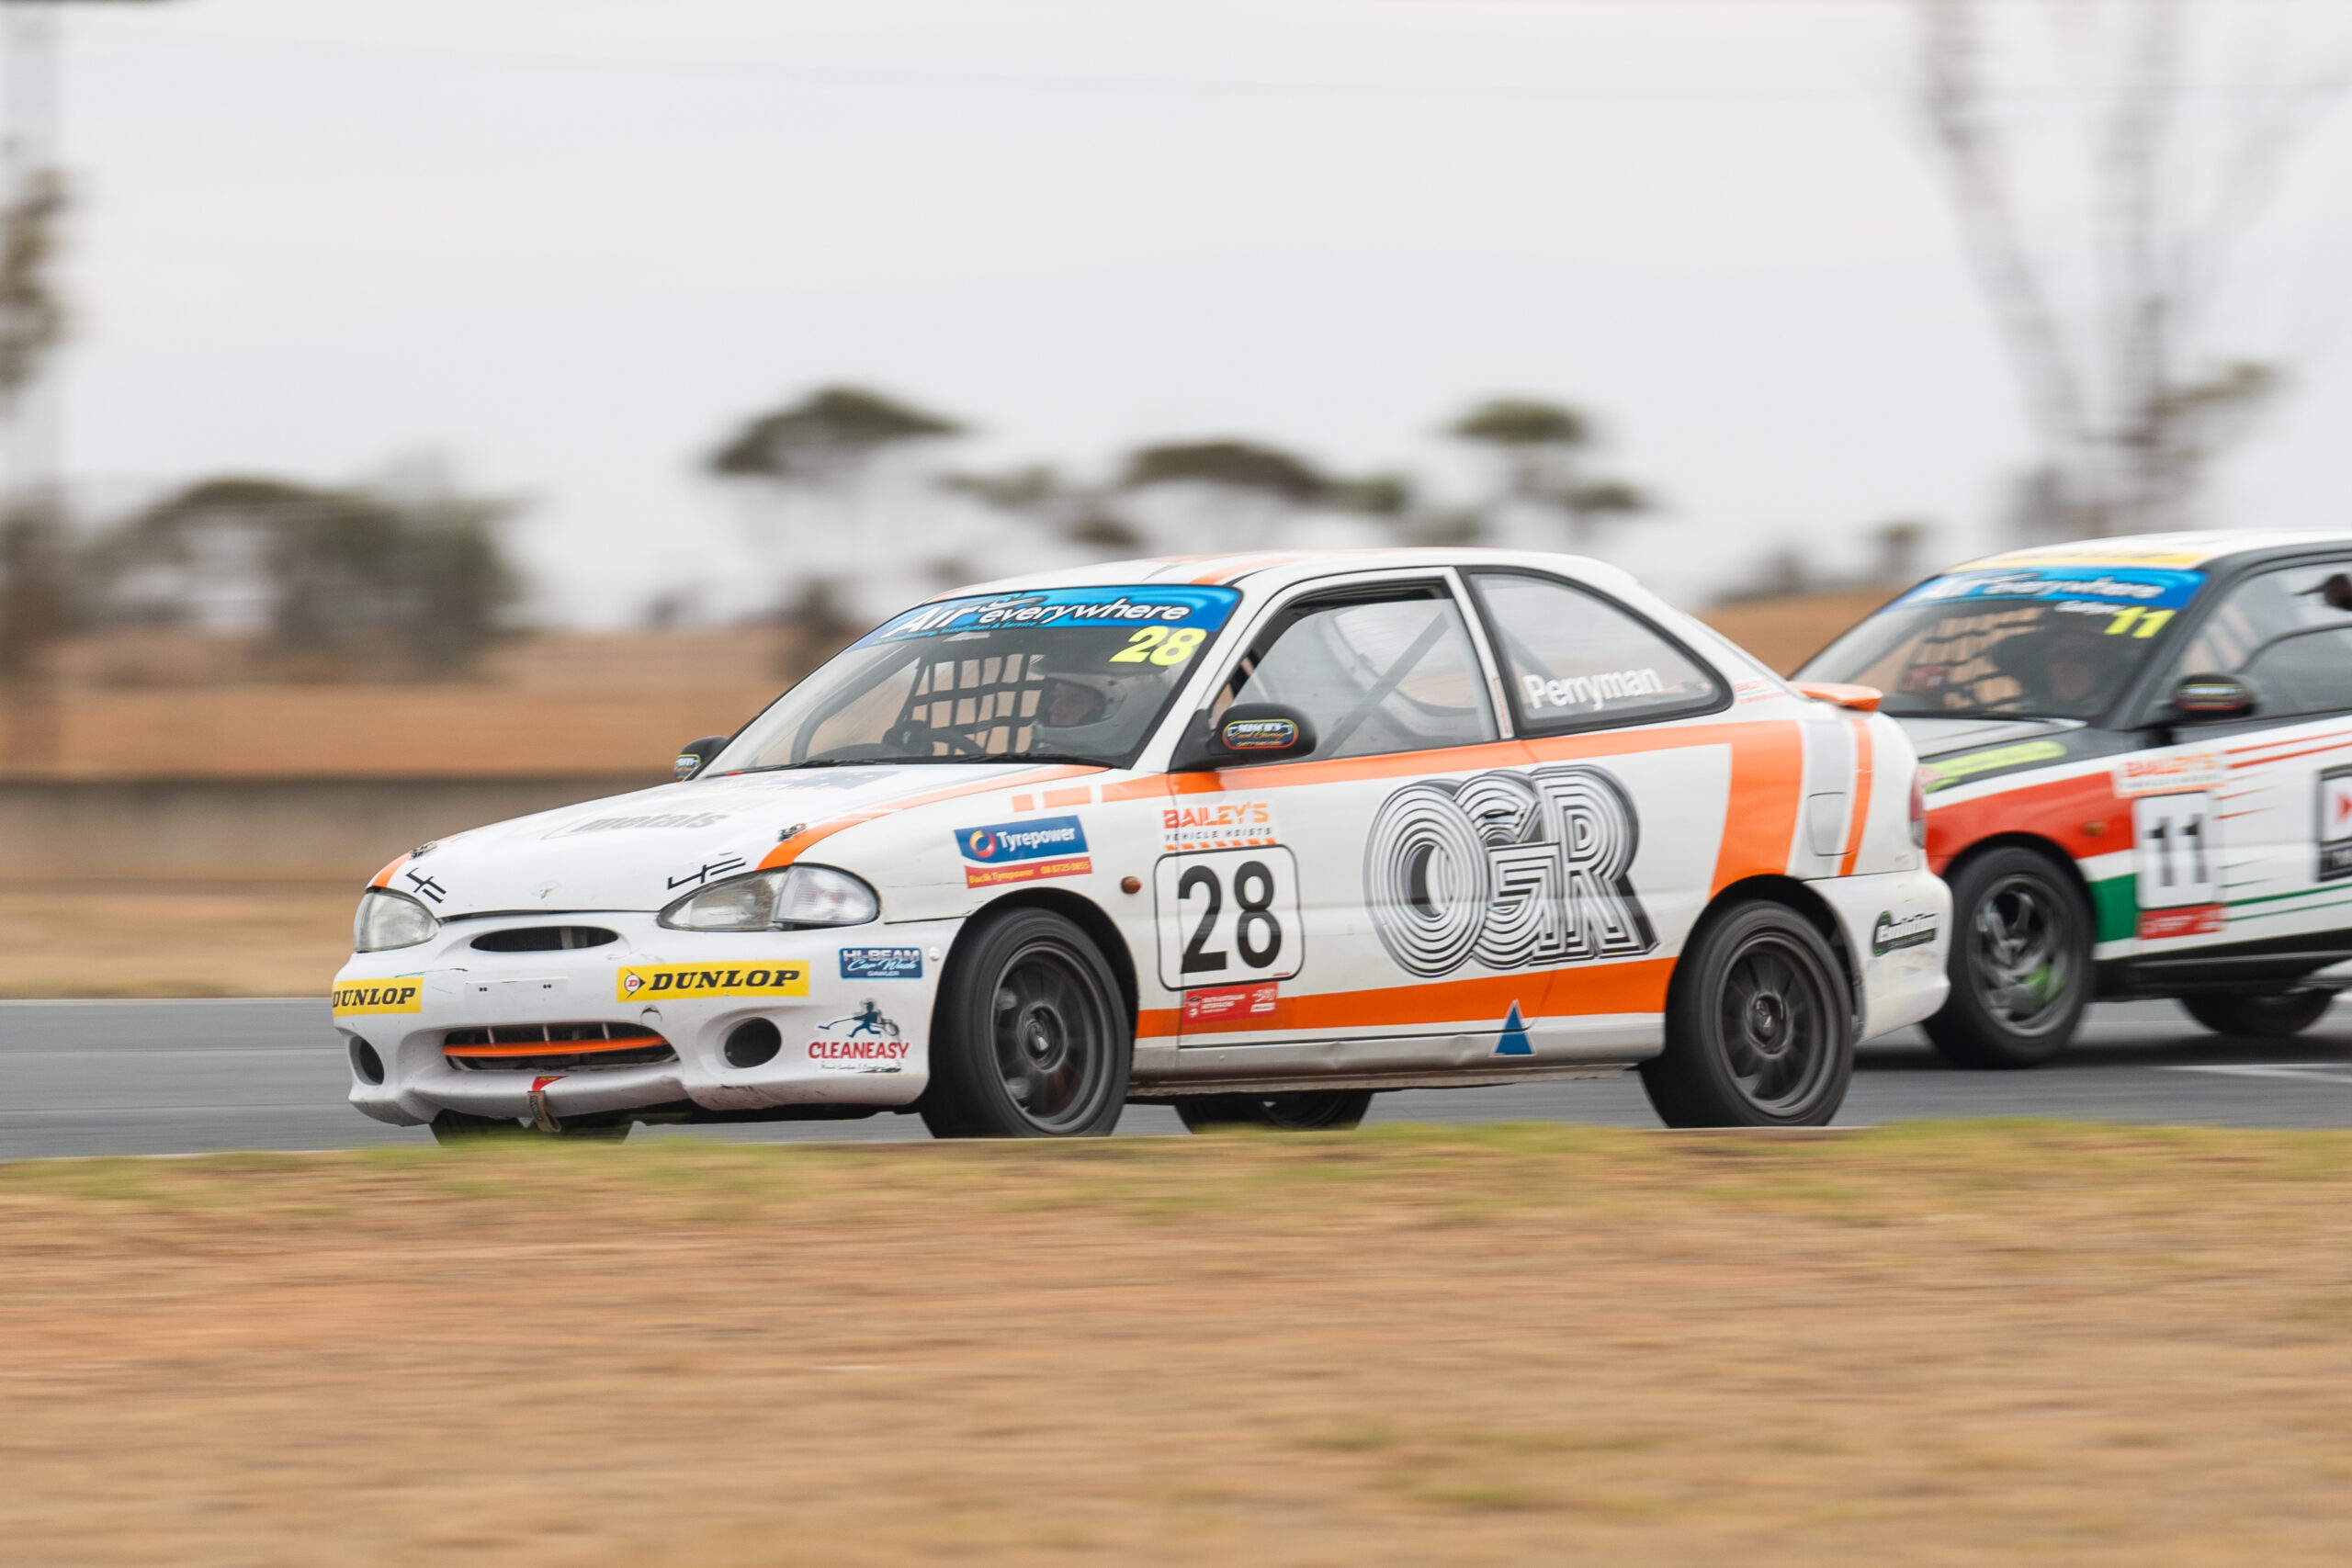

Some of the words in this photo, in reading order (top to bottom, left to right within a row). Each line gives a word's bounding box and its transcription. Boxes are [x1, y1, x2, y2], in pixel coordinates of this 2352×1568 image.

[978, 598, 1190, 624] everywhere
[2103, 606, 2177, 638] 11
[1109, 626, 1206, 666] 28
[1522, 668, 1664, 711] Perryman
[1162, 801, 1270, 829] BAILEY'S
[996, 828, 1076, 852] Tyrepower
[1165, 830, 1218, 841] VEHICLE
[1225, 828, 1272, 838] HOISTS
[2143, 813, 2209, 886] 11
[1178, 860, 1282, 974] 28
[842, 950, 920, 961] HI-BEAM
[847, 958, 877, 971] Car
[649, 969, 800, 991] DUNLOP
[332, 987, 416, 1008] DUNLOP
[808, 1041, 910, 1059] CLEANEASY
